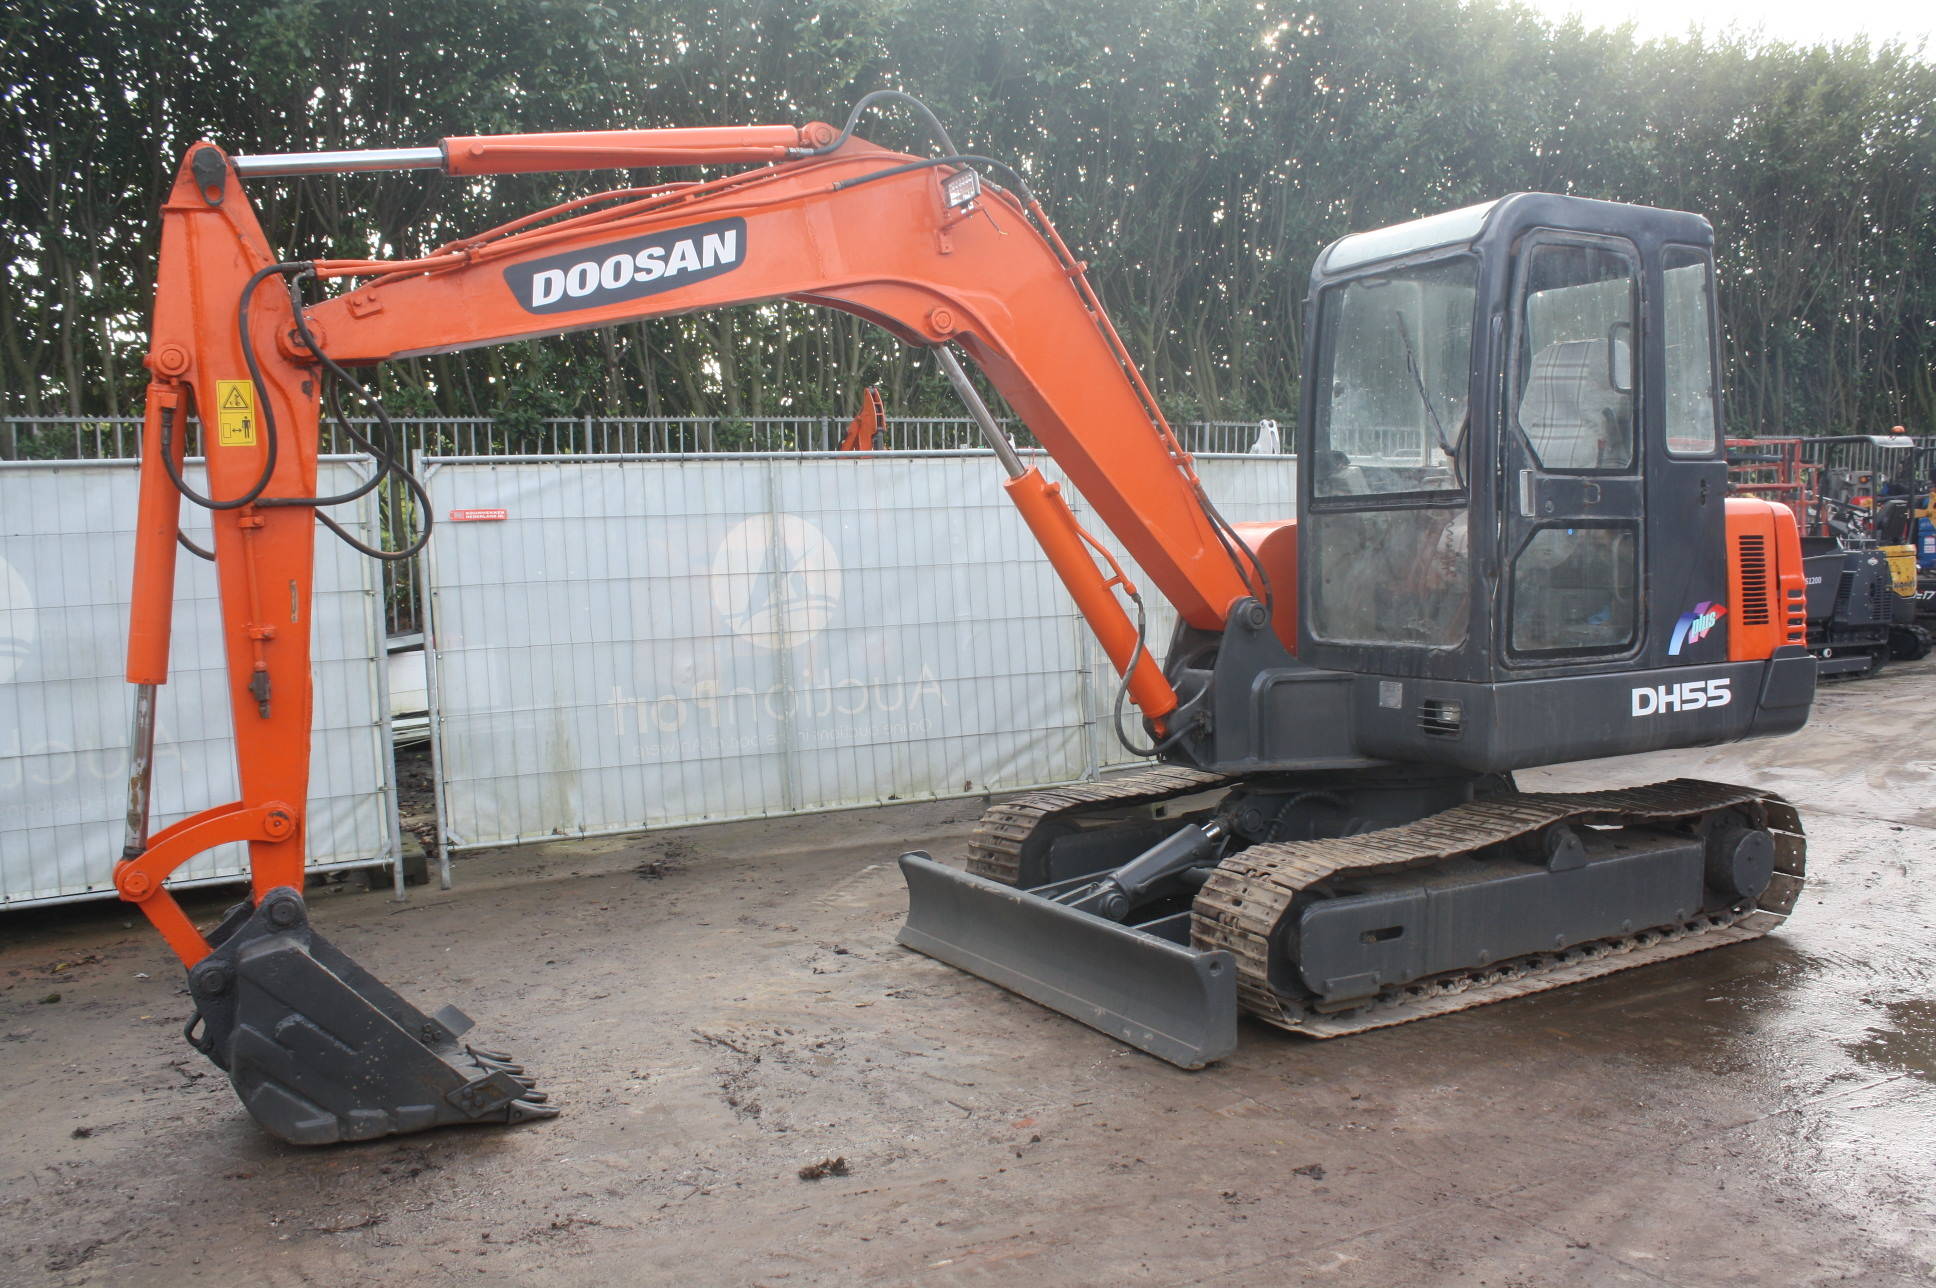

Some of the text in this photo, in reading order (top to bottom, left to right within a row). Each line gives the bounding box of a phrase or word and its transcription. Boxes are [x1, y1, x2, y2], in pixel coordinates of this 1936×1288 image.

[532, 230, 736, 307] DOOSAN
[1691, 611, 1716, 637] plus
[1632, 677, 1731, 716] DH55
